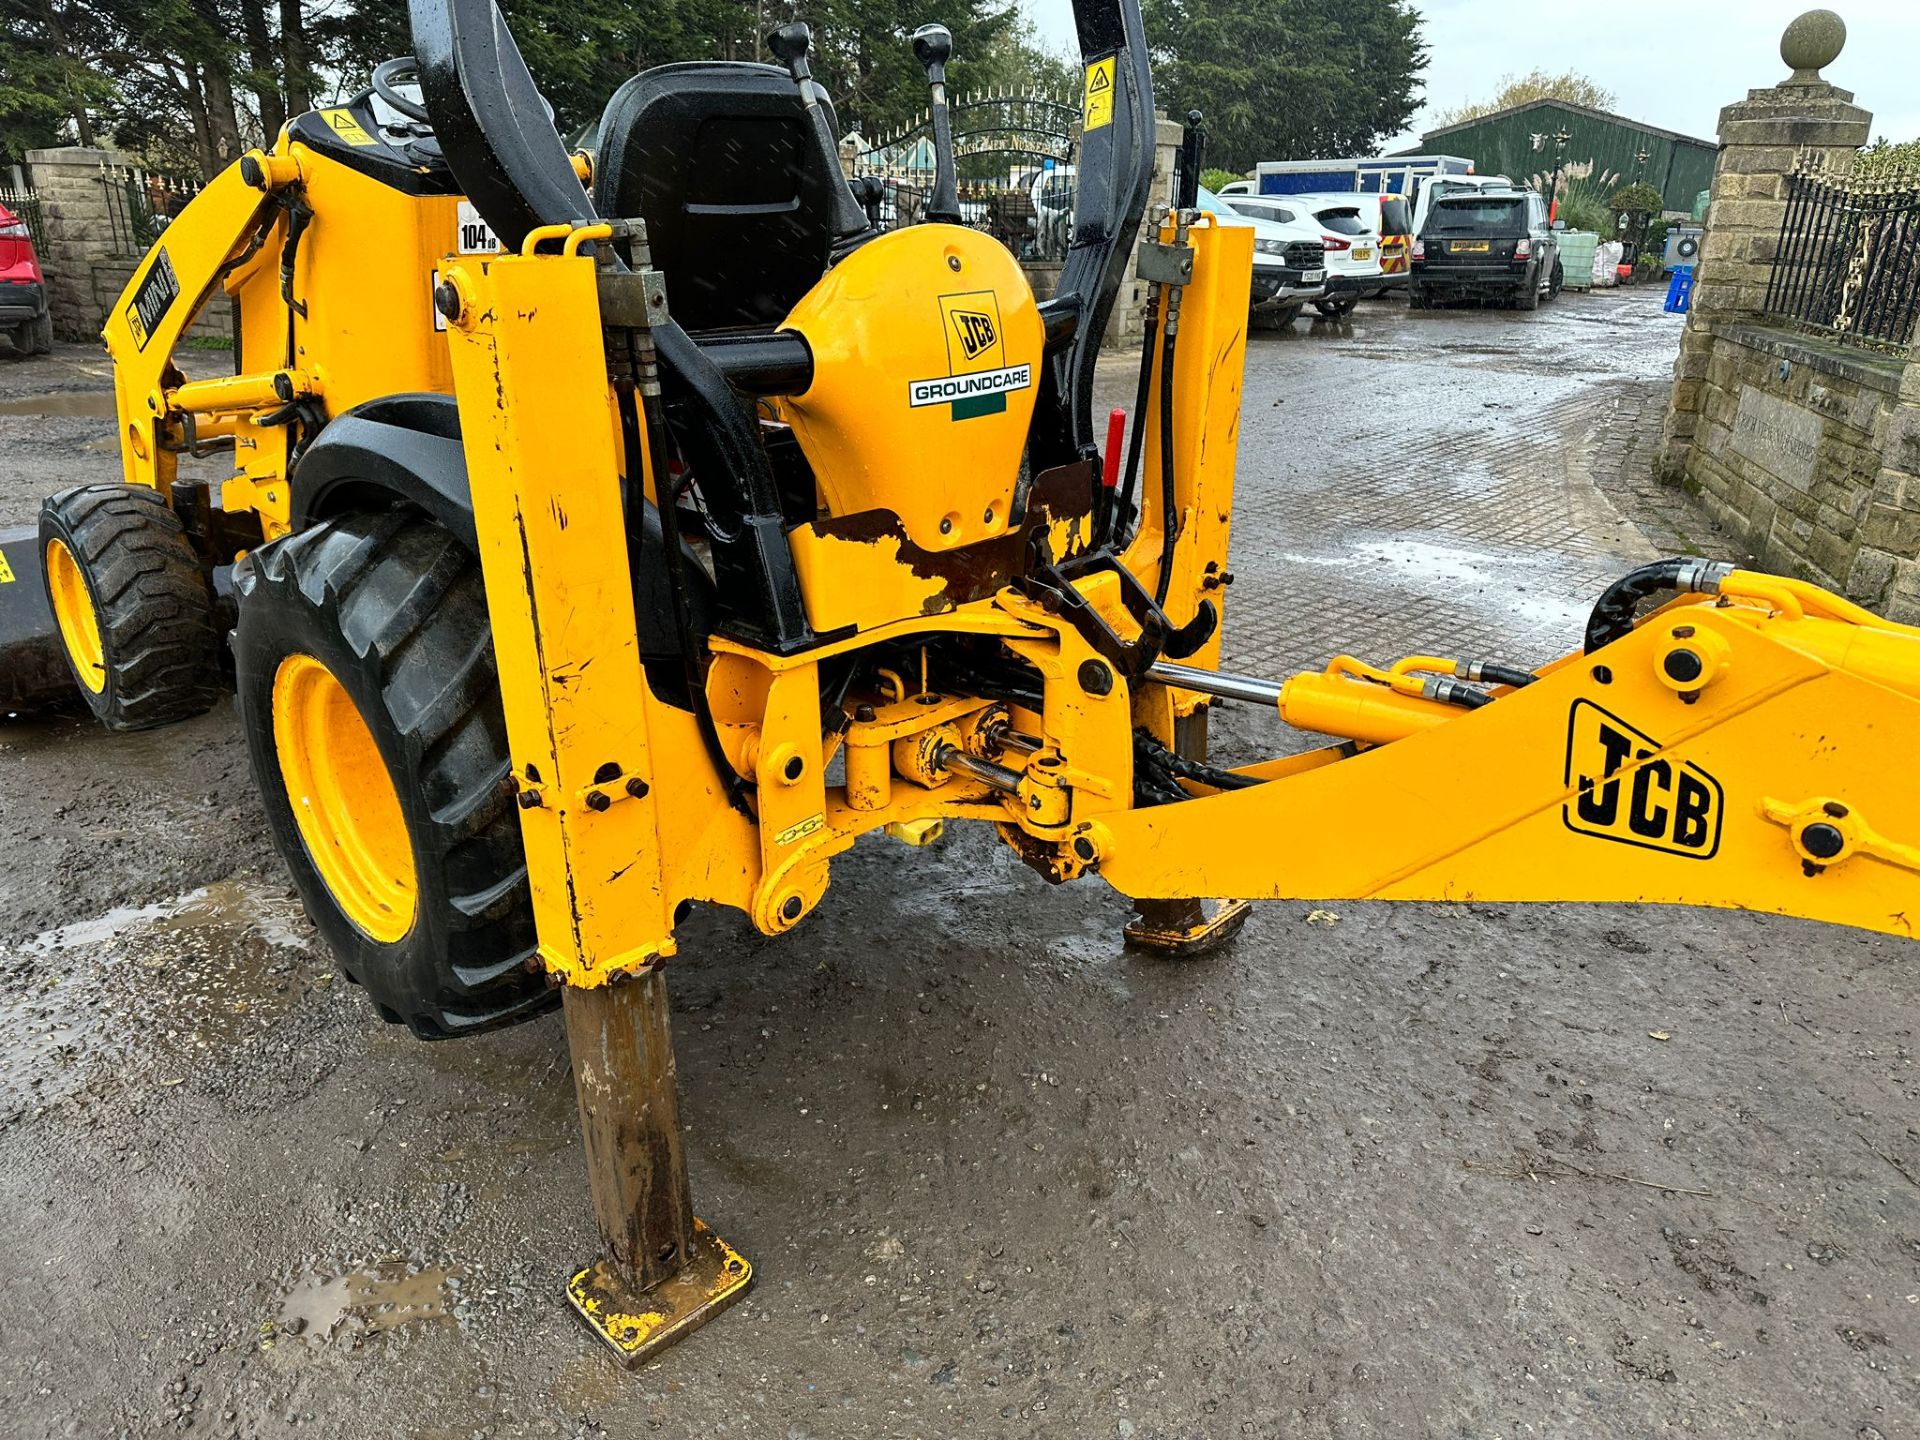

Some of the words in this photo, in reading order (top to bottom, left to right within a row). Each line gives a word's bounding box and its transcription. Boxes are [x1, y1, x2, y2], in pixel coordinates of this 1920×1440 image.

[461, 224, 487, 250] 104
[138, 268, 170, 329] MINI
[959, 315, 995, 354] JCB
[915, 369, 1029, 401] GROUNDCARE
[1577, 722, 1711, 848] JCB
